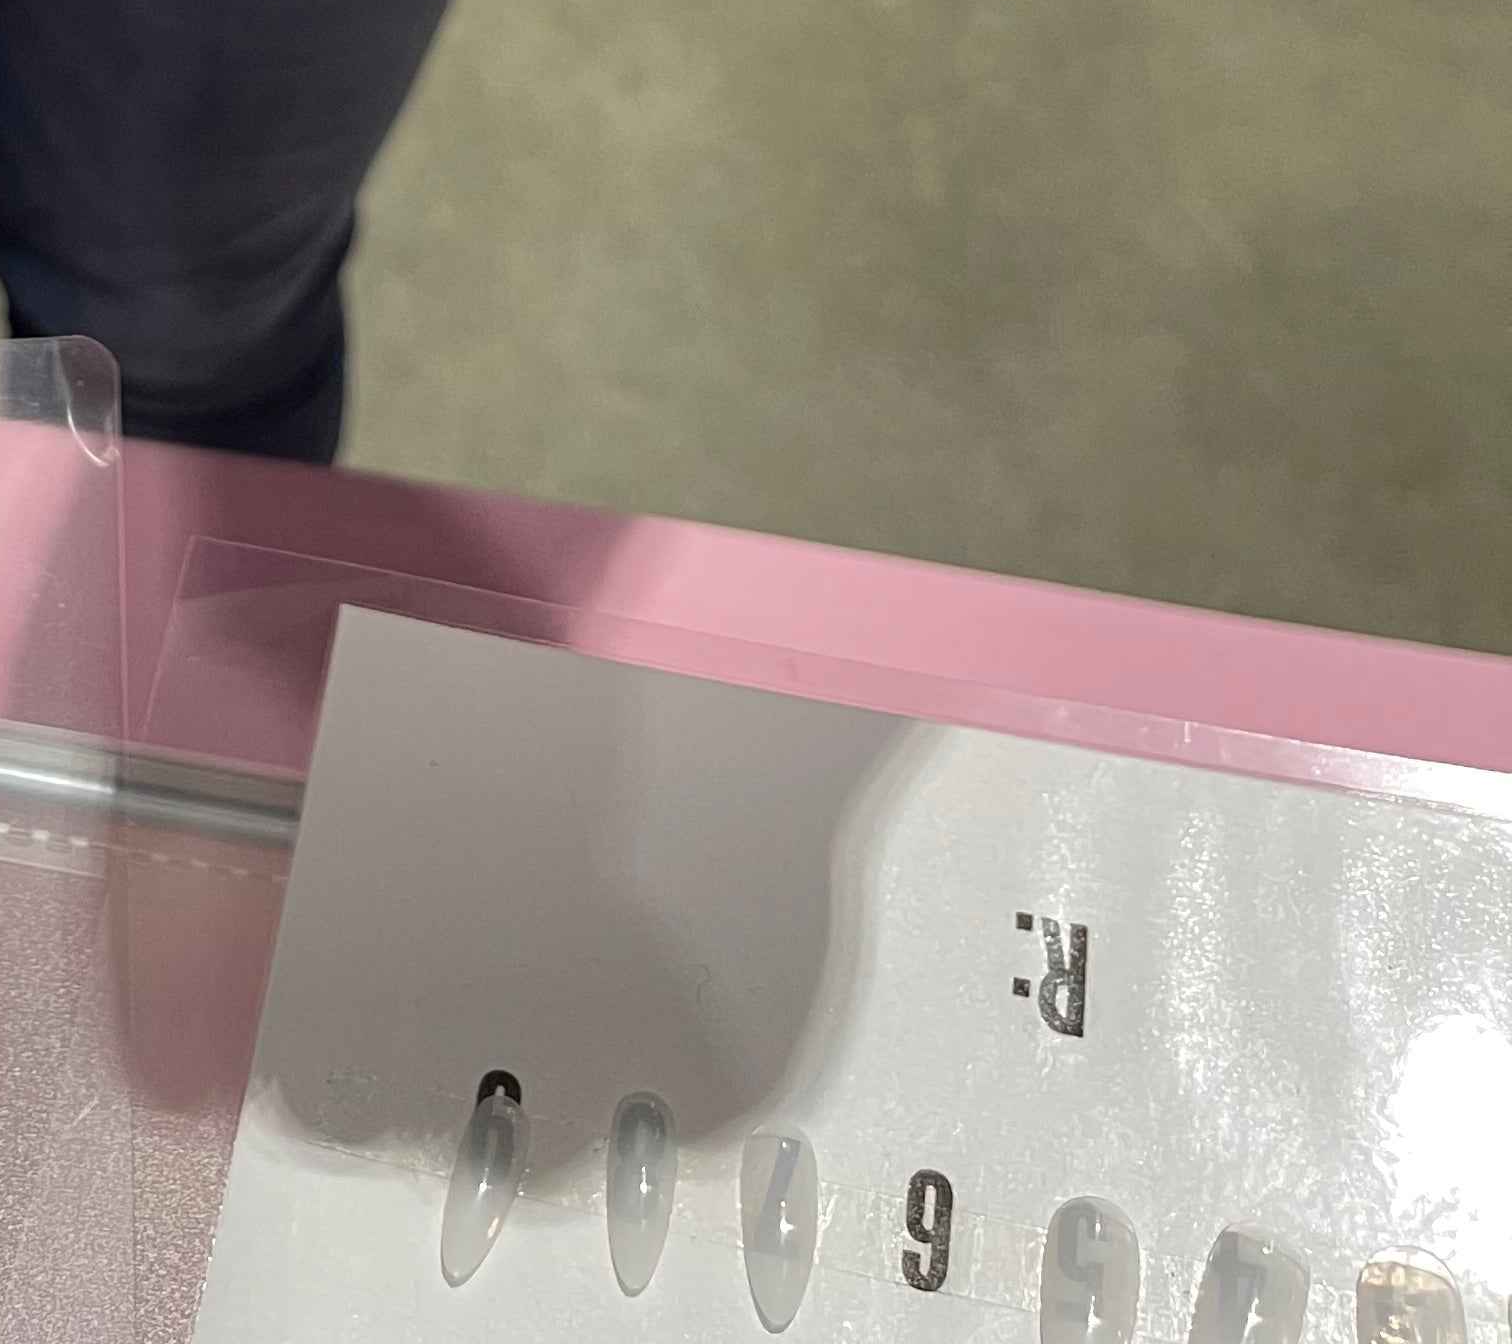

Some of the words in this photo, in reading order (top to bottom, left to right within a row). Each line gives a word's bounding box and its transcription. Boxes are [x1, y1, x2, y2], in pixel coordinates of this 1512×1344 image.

[1011, 912, 1088, 1038] R:
[744, 1136, 800, 1261] 7
[901, 1169, 955, 1293] 6
